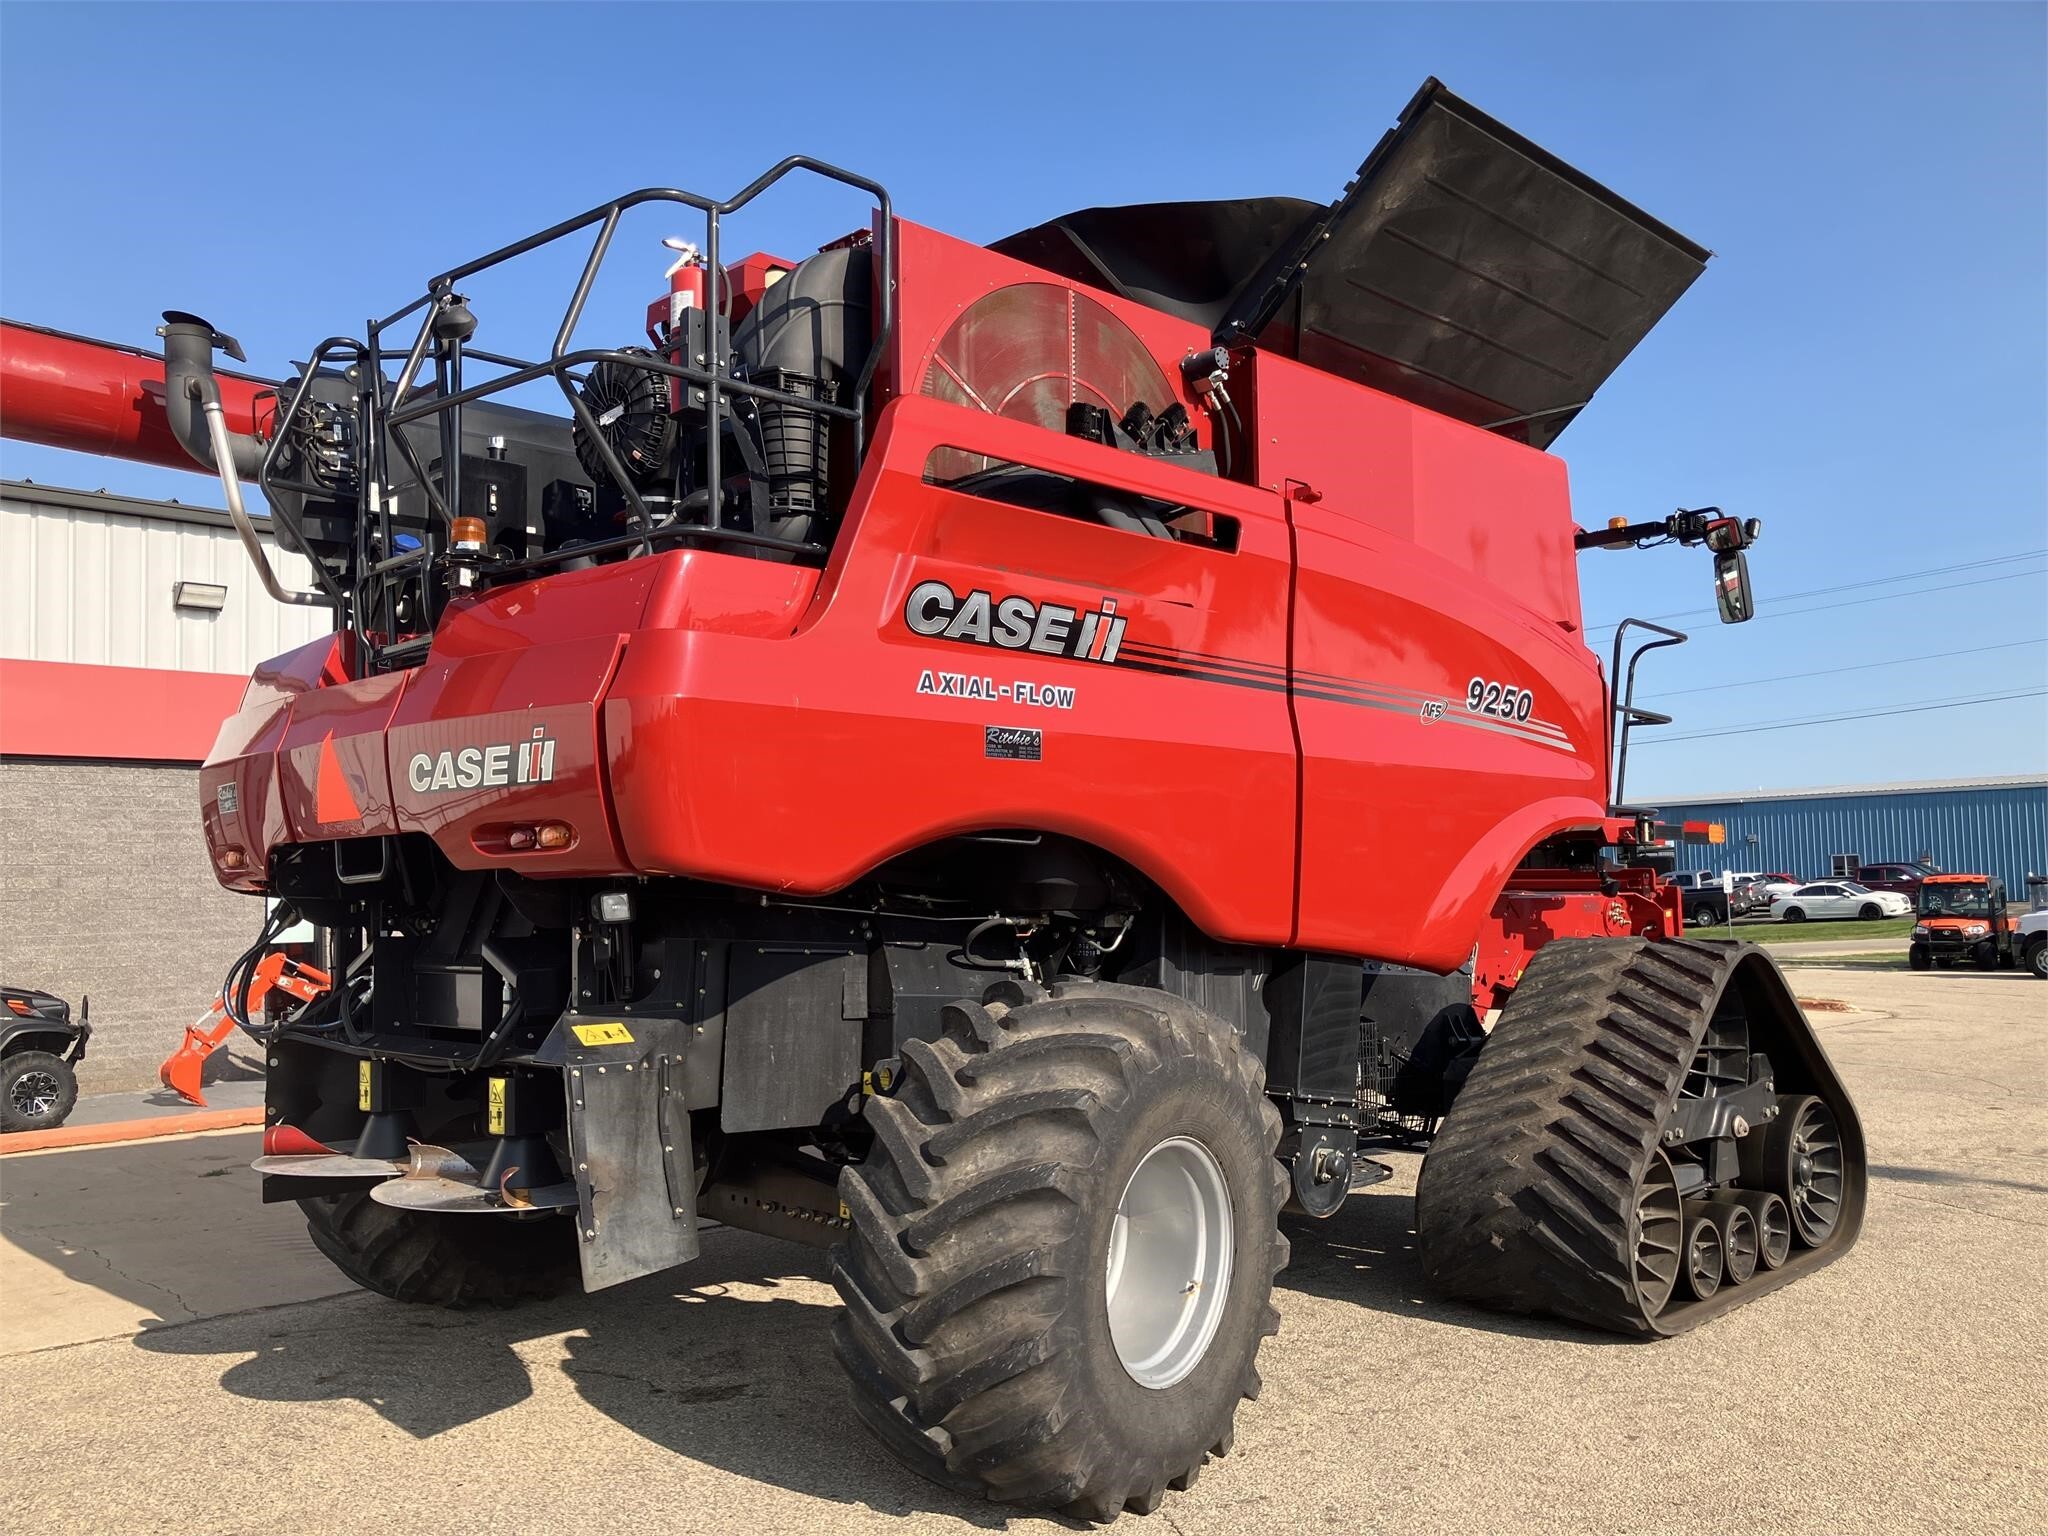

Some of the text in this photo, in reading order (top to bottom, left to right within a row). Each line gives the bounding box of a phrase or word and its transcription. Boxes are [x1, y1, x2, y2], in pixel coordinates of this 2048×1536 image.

[906, 581, 1076, 655] CASE
[916, 670, 1075, 709] AXIAL-FLOW
[1421, 700, 1443, 718] AFS
[1466, 677, 1533, 723] 9250
[986, 727, 1041, 746] Ritchie's
[408, 747, 509, 793] CASE
